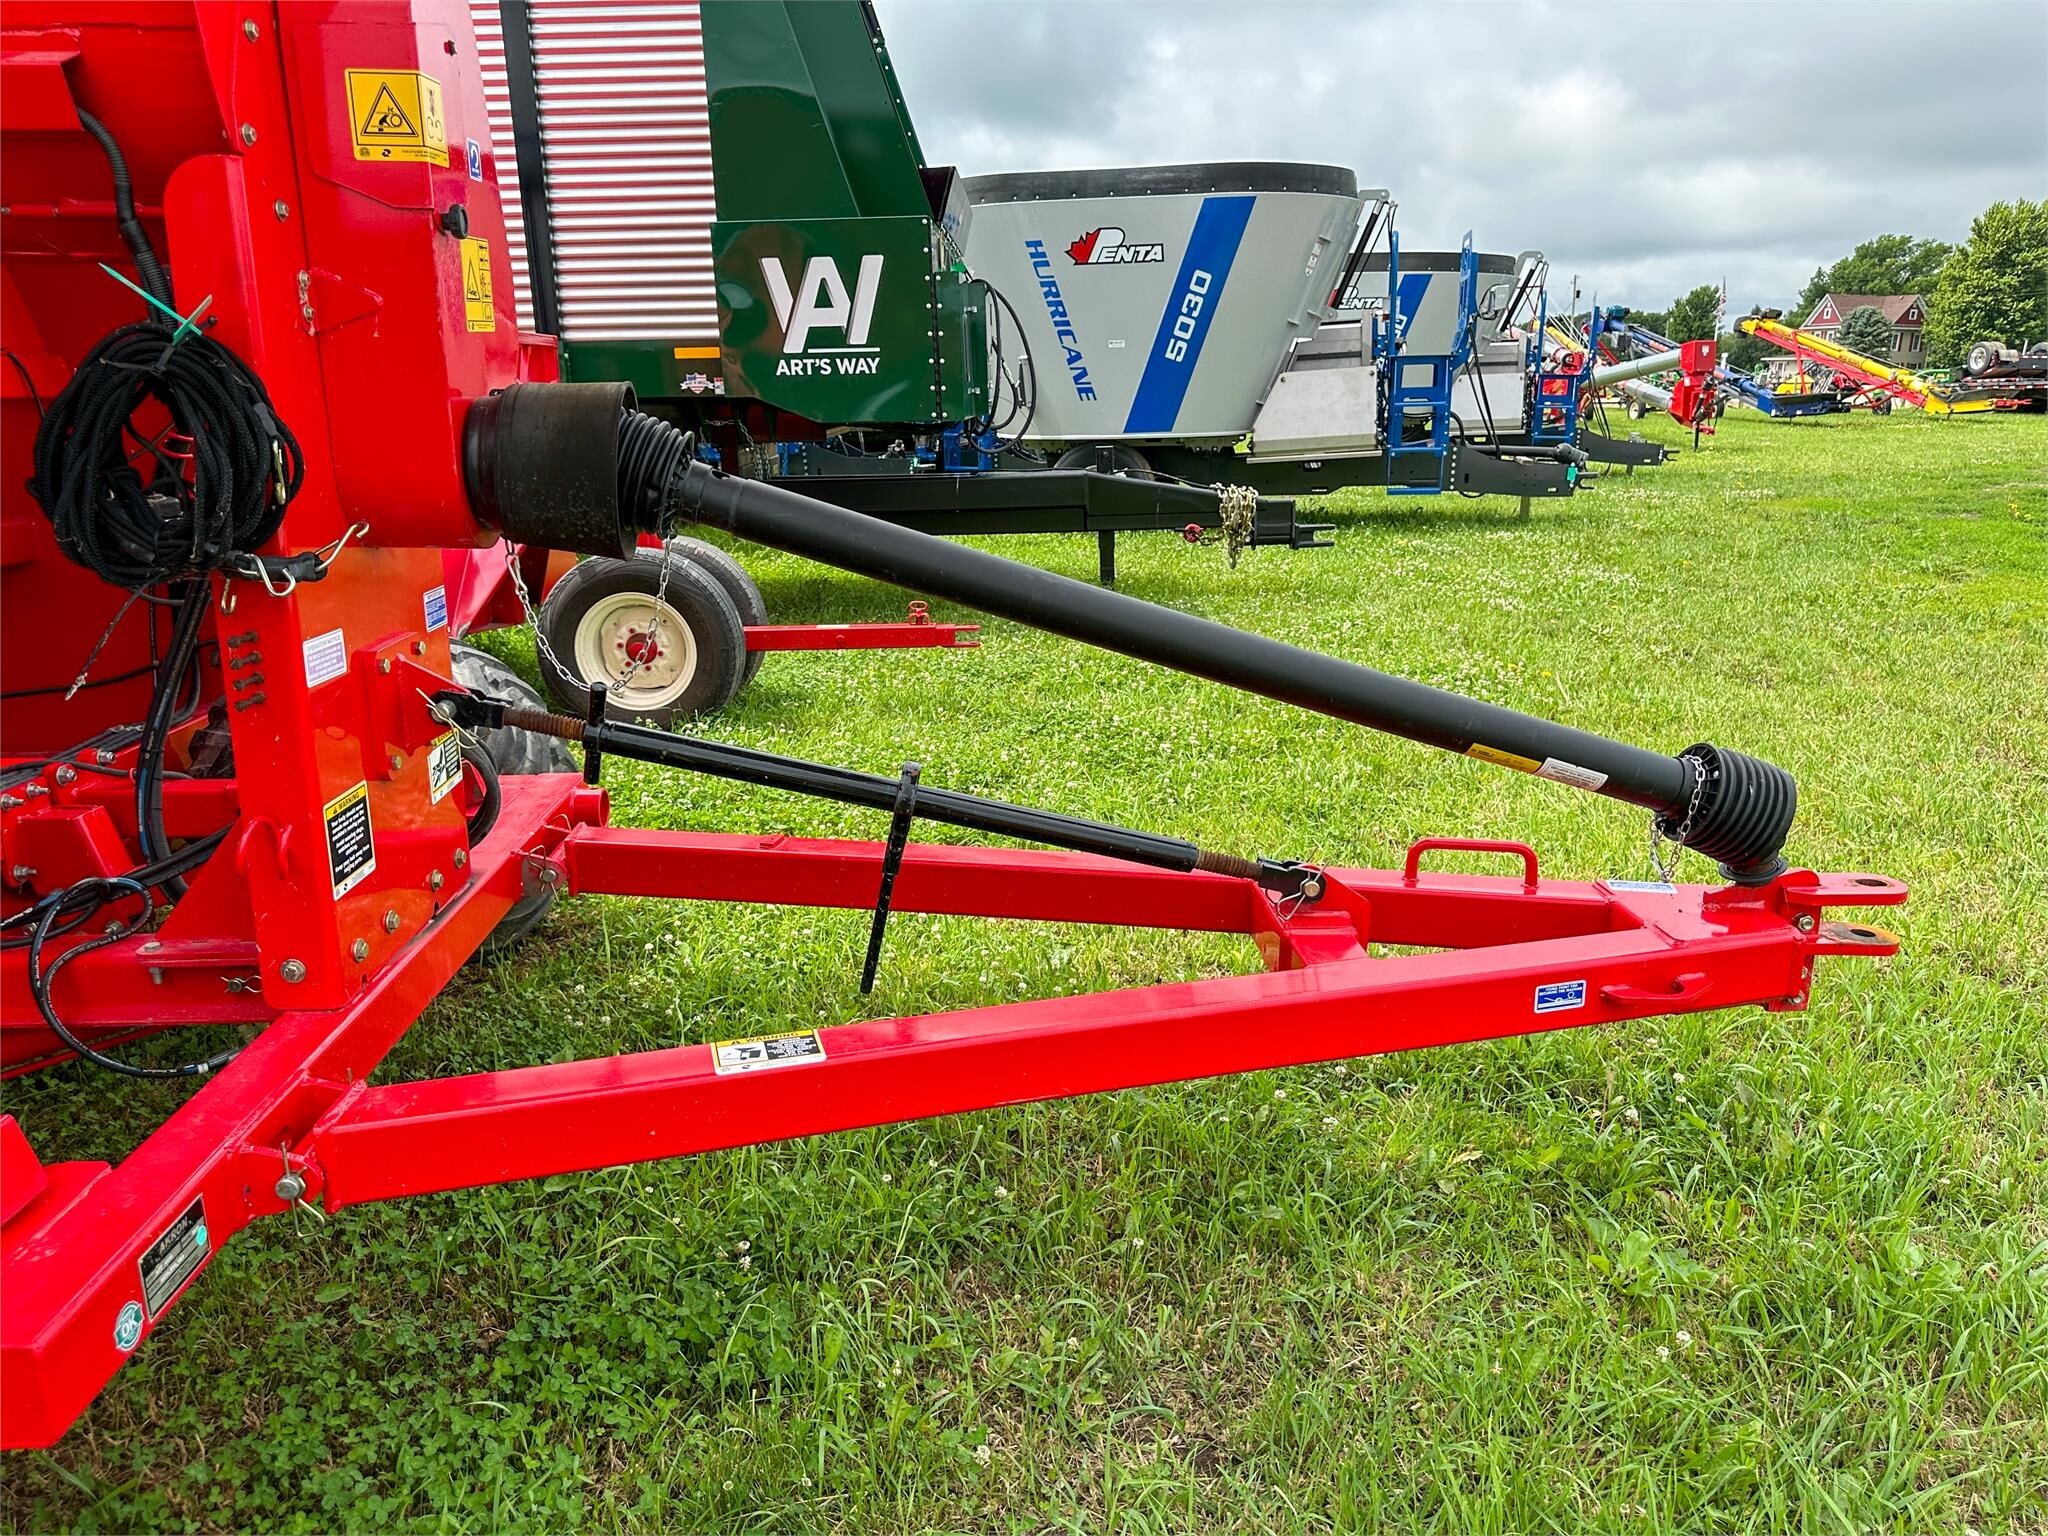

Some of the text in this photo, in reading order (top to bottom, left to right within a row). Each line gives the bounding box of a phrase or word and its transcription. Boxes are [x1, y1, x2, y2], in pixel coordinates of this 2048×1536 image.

[1088, 227, 1164, 264] PENTA
[1024, 240, 1098, 402] HURRICANE
[1165, 269, 1213, 363] 5030
[776, 357, 881, 376] ART'S WAY
[338, 791, 359, 810] WARNING
[745, 1032, 799, 1043] WARNING
[158, 1217, 188, 1253] AKRON
[121, 1312, 138, 1337] OK
